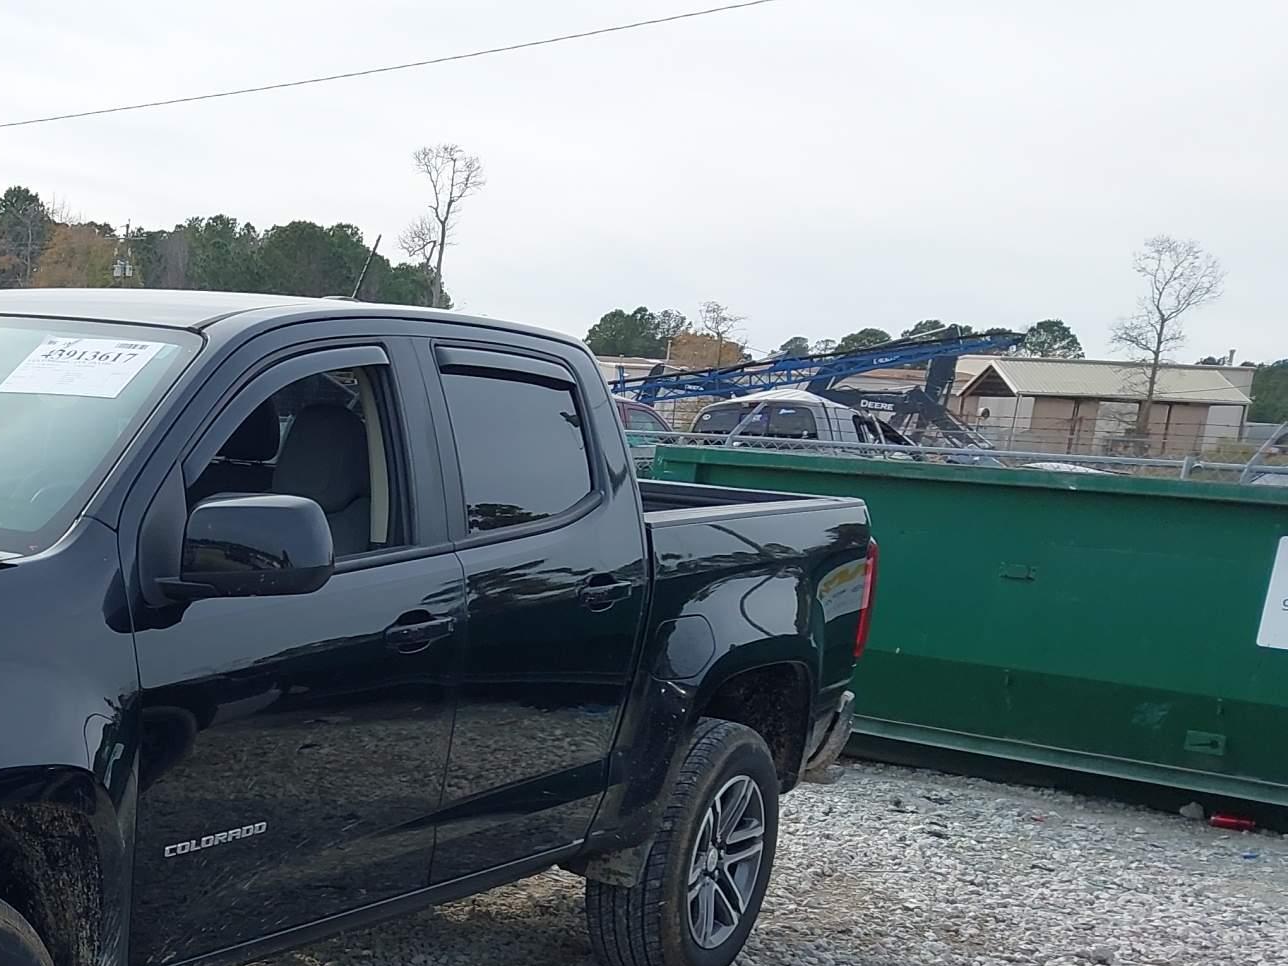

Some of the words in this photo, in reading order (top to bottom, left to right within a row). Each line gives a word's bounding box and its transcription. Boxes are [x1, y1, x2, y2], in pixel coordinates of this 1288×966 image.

[41, 349, 137, 364] 43913617
[860, 399, 895, 411] DEERE
[164, 821, 267, 858] COLORADO
